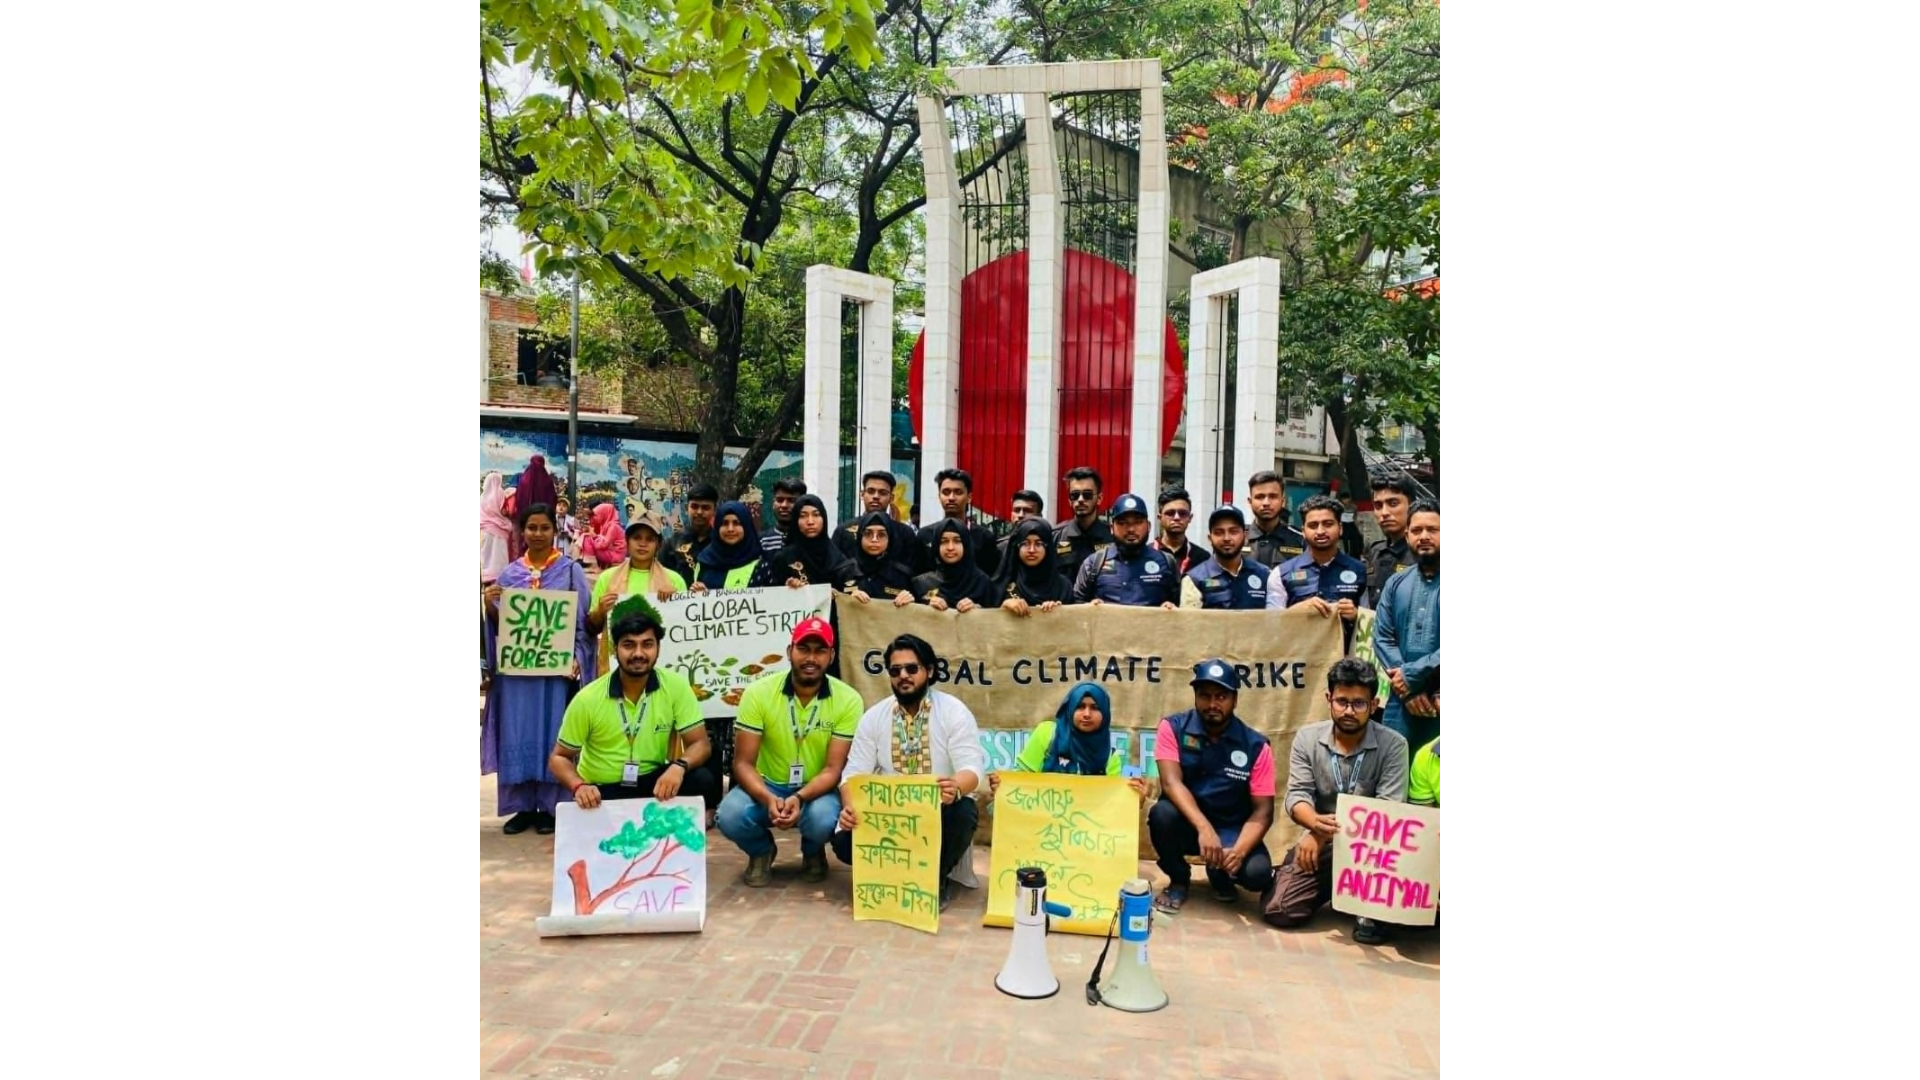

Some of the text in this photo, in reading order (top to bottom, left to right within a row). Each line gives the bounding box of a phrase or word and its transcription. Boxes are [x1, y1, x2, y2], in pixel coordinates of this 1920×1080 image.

[505, 594, 570, 630] SAVE
[685, 598, 767, 622] GLOBAL
[509, 626, 555, 650] THE
[669, 618, 750, 643] CLIMATE
[500, 645, 572, 669] FOREST
[863, 651, 1307, 689] GBAL CLIMATE RIKE
[705, 677, 731, 688] SAVE
[860, 781, 892, 807] পদ্মা
[1345, 806, 1425, 852] SAVE
[1349, 842, 1400, 872] THE
[613, 885, 690, 914] SAVE
[1336, 867, 1434, 909] ANIMAL
